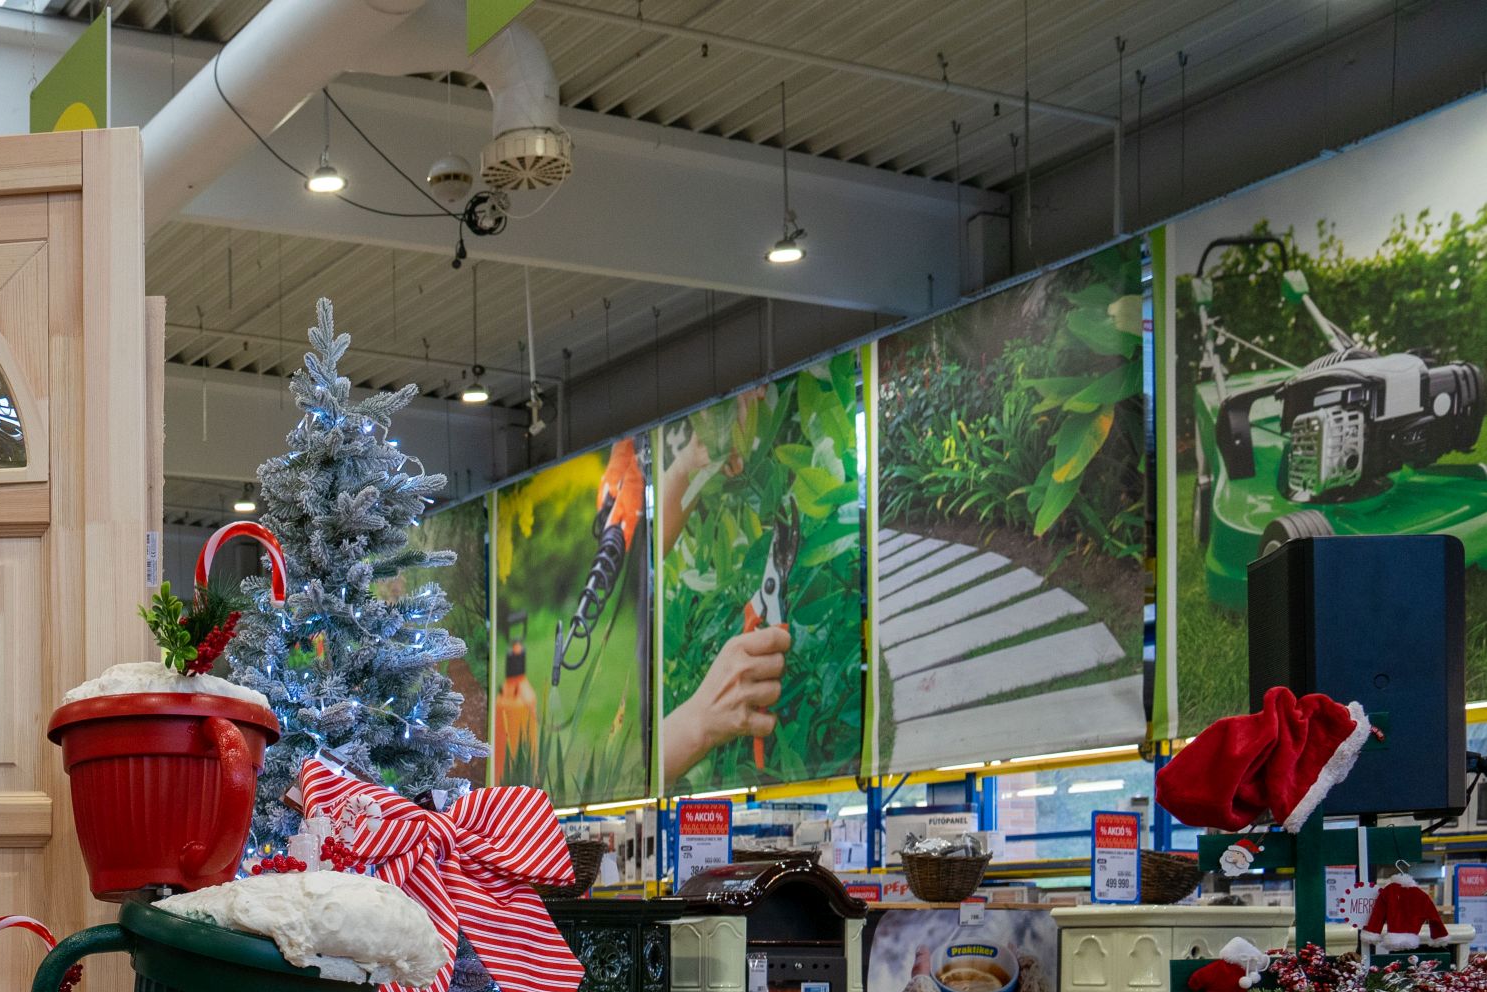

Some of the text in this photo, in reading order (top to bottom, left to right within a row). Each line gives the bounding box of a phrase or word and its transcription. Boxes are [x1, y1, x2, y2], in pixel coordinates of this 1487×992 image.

[694, 812, 715, 822] AKCIÓ
[1108, 826, 1125, 836] AKCIÓ
[951, 945, 995, 957] Praktiker
